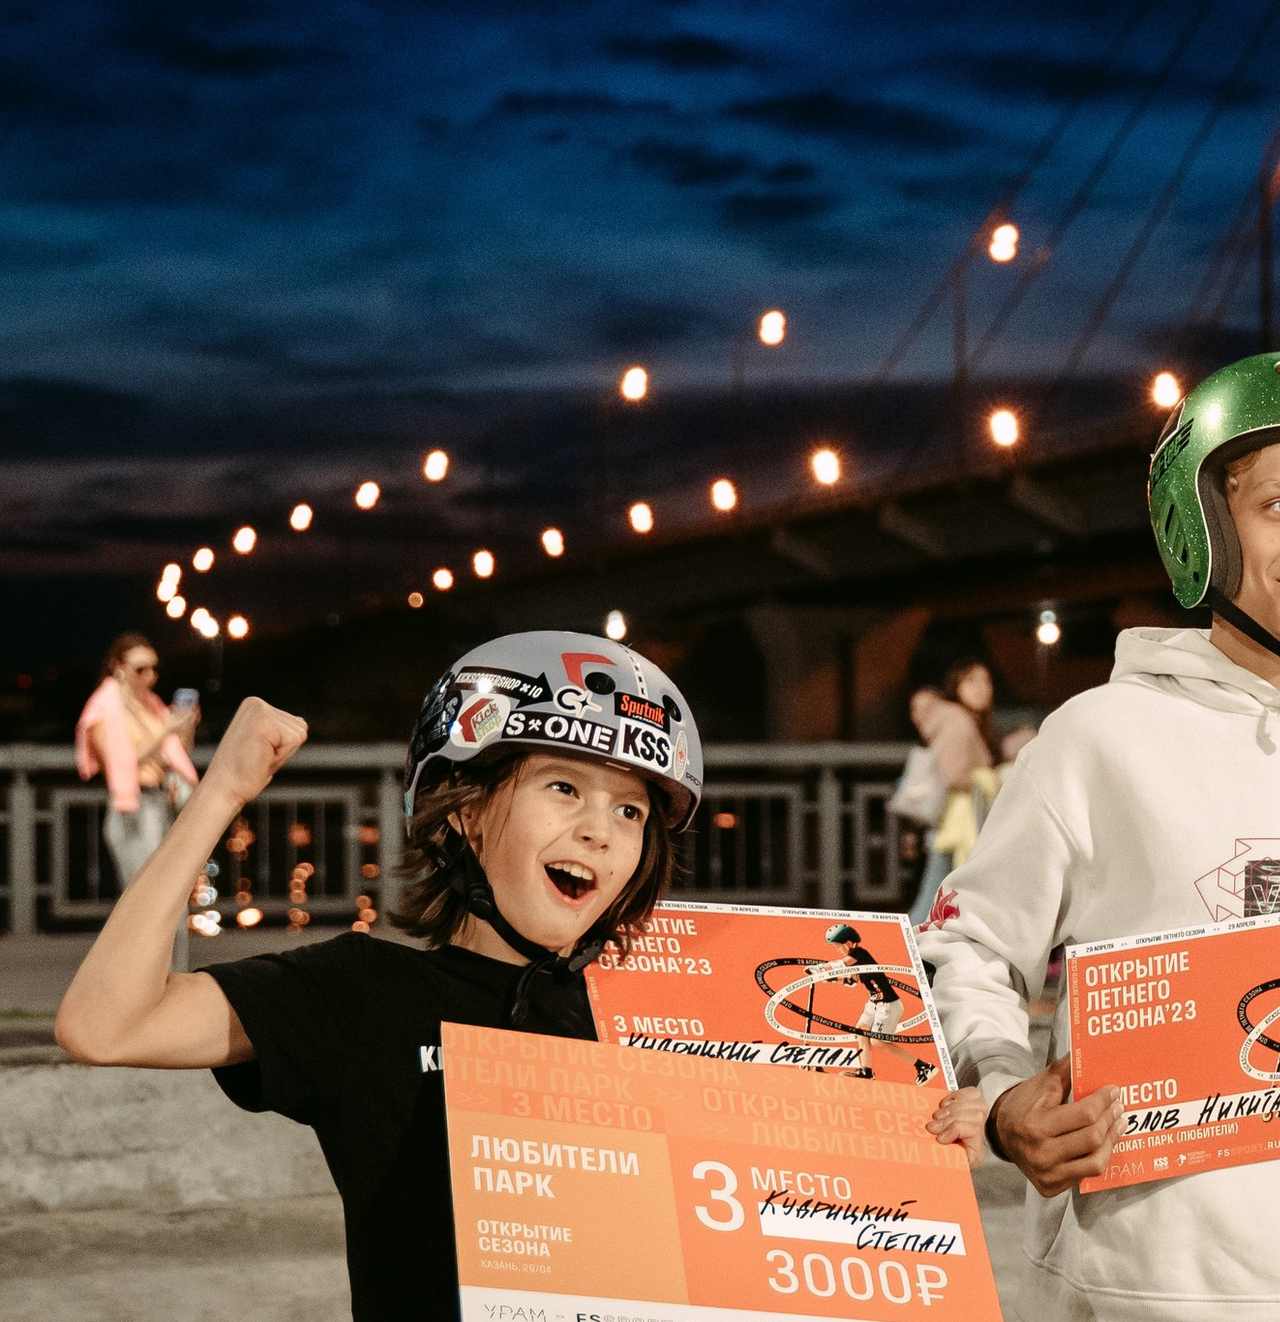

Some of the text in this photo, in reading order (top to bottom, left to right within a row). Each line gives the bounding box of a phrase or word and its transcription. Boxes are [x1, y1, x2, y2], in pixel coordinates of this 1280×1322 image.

[620, 694, 665, 725] Sputnik
[622, 723, 670, 769] KSS
[1085, 951, 1190, 987] ОТКРЫТИЕ
[1086, 979, 1170, 1012] ЛЕТНЕГО
[613, 1015, 705, 1036] 3 МЕСТО
[617, 1051, 742, 1087] СЕЗОНА
[552, 1067, 633, 1102] ПАРК
[702, 1086, 867, 1131] ОТКРЫТИЕ
[512, 1091, 531, 1117] 3
[543, 1094, 653, 1131] МЕСТО
[751, 1119, 921, 1165] ЛЮБИТЕЛИ
[1147, 1132, 1174, 1148] ПАРК
[1176, 1122, 1239, 1144] (ЛЮБИТЕЛИ)
[471, 1134, 640, 1176] ЛЮБИТЕЛИ
[1153, 1156, 1169, 1170] KSS
[473, 1166, 556, 1198] ПАРК
[692, 1160, 852, 1232] 3 МЕСТО
[477, 1219, 573, 1243] ОТКРЫТИЕ
[478, 1236, 551, 1258] СЕЗОНА
[522, 1262, 552, 1274] 29/04
